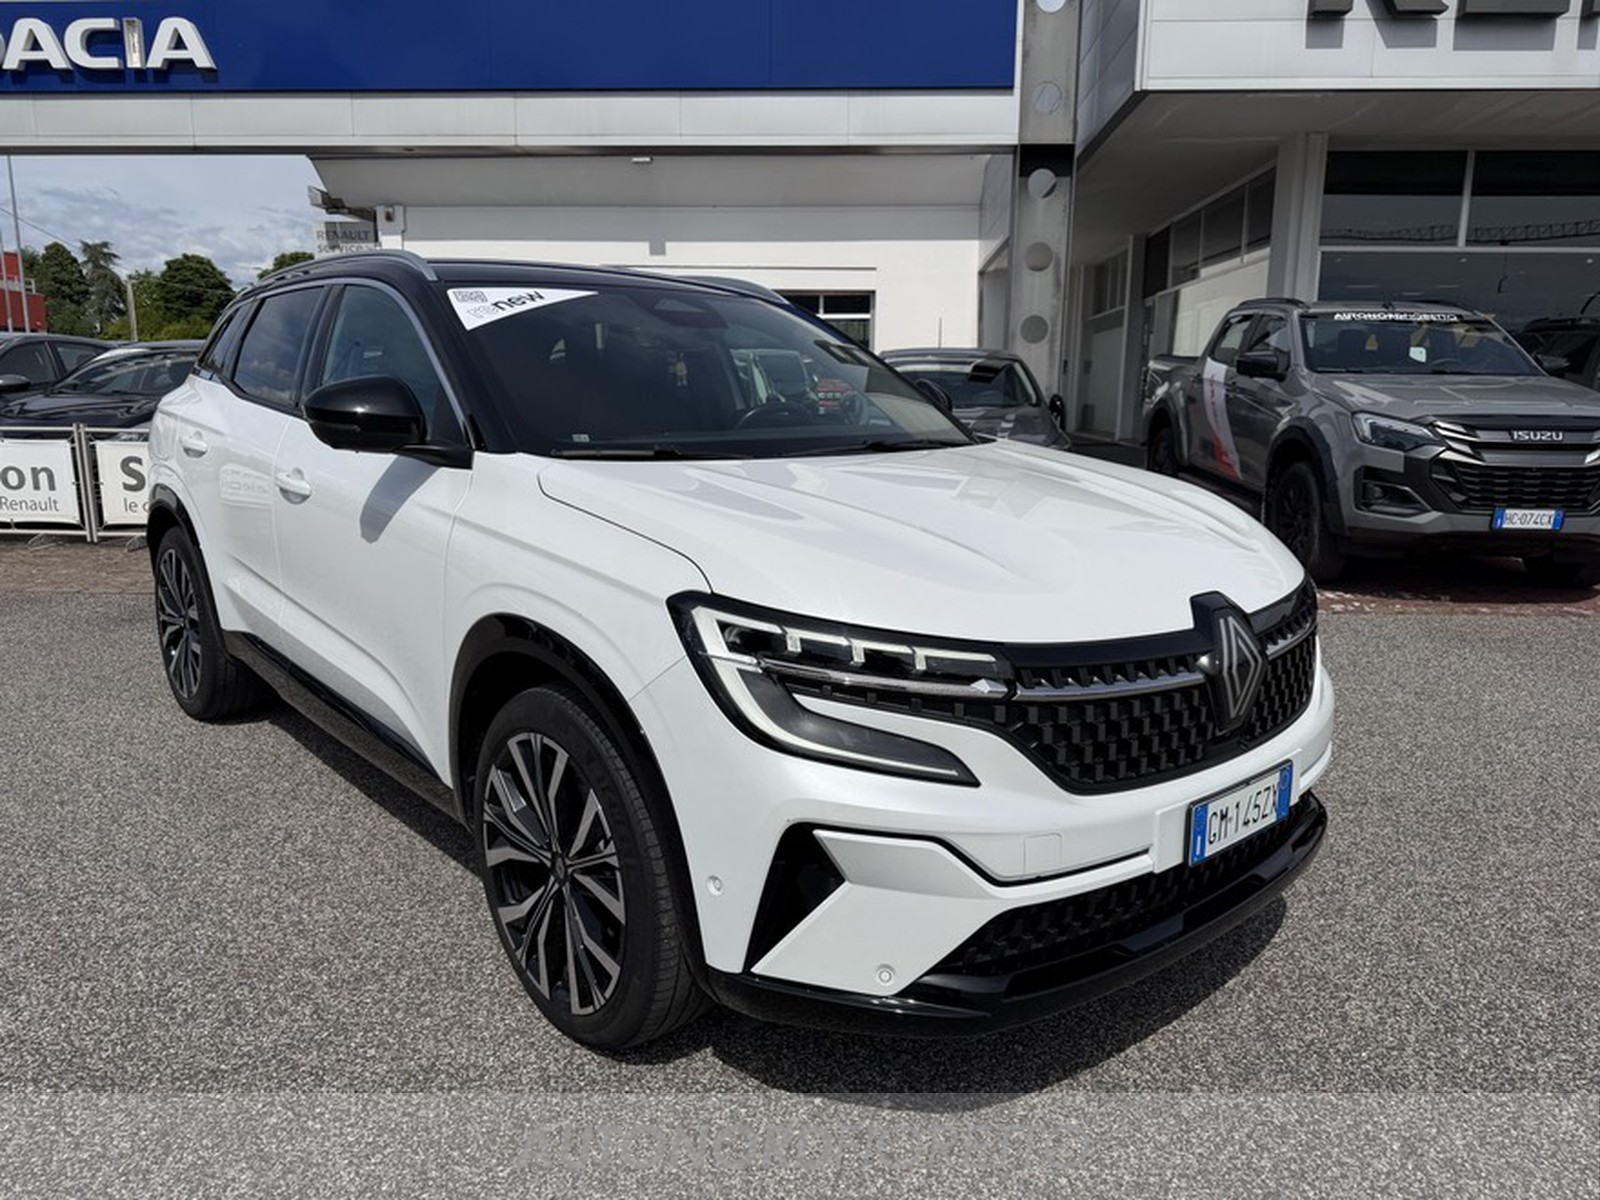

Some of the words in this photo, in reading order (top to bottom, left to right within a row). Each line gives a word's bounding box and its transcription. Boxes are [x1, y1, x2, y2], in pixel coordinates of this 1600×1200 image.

[0, 17, 217, 70] ACIA
[317, 230, 370, 240] RENAULT
[1513, 430, 1563, 440] ISUZU
[0, 466, 56, 491] on
[120, 455, 146, 492] S
[0, 496, 59, 512] Renault
[124, 497, 139, 513] le
